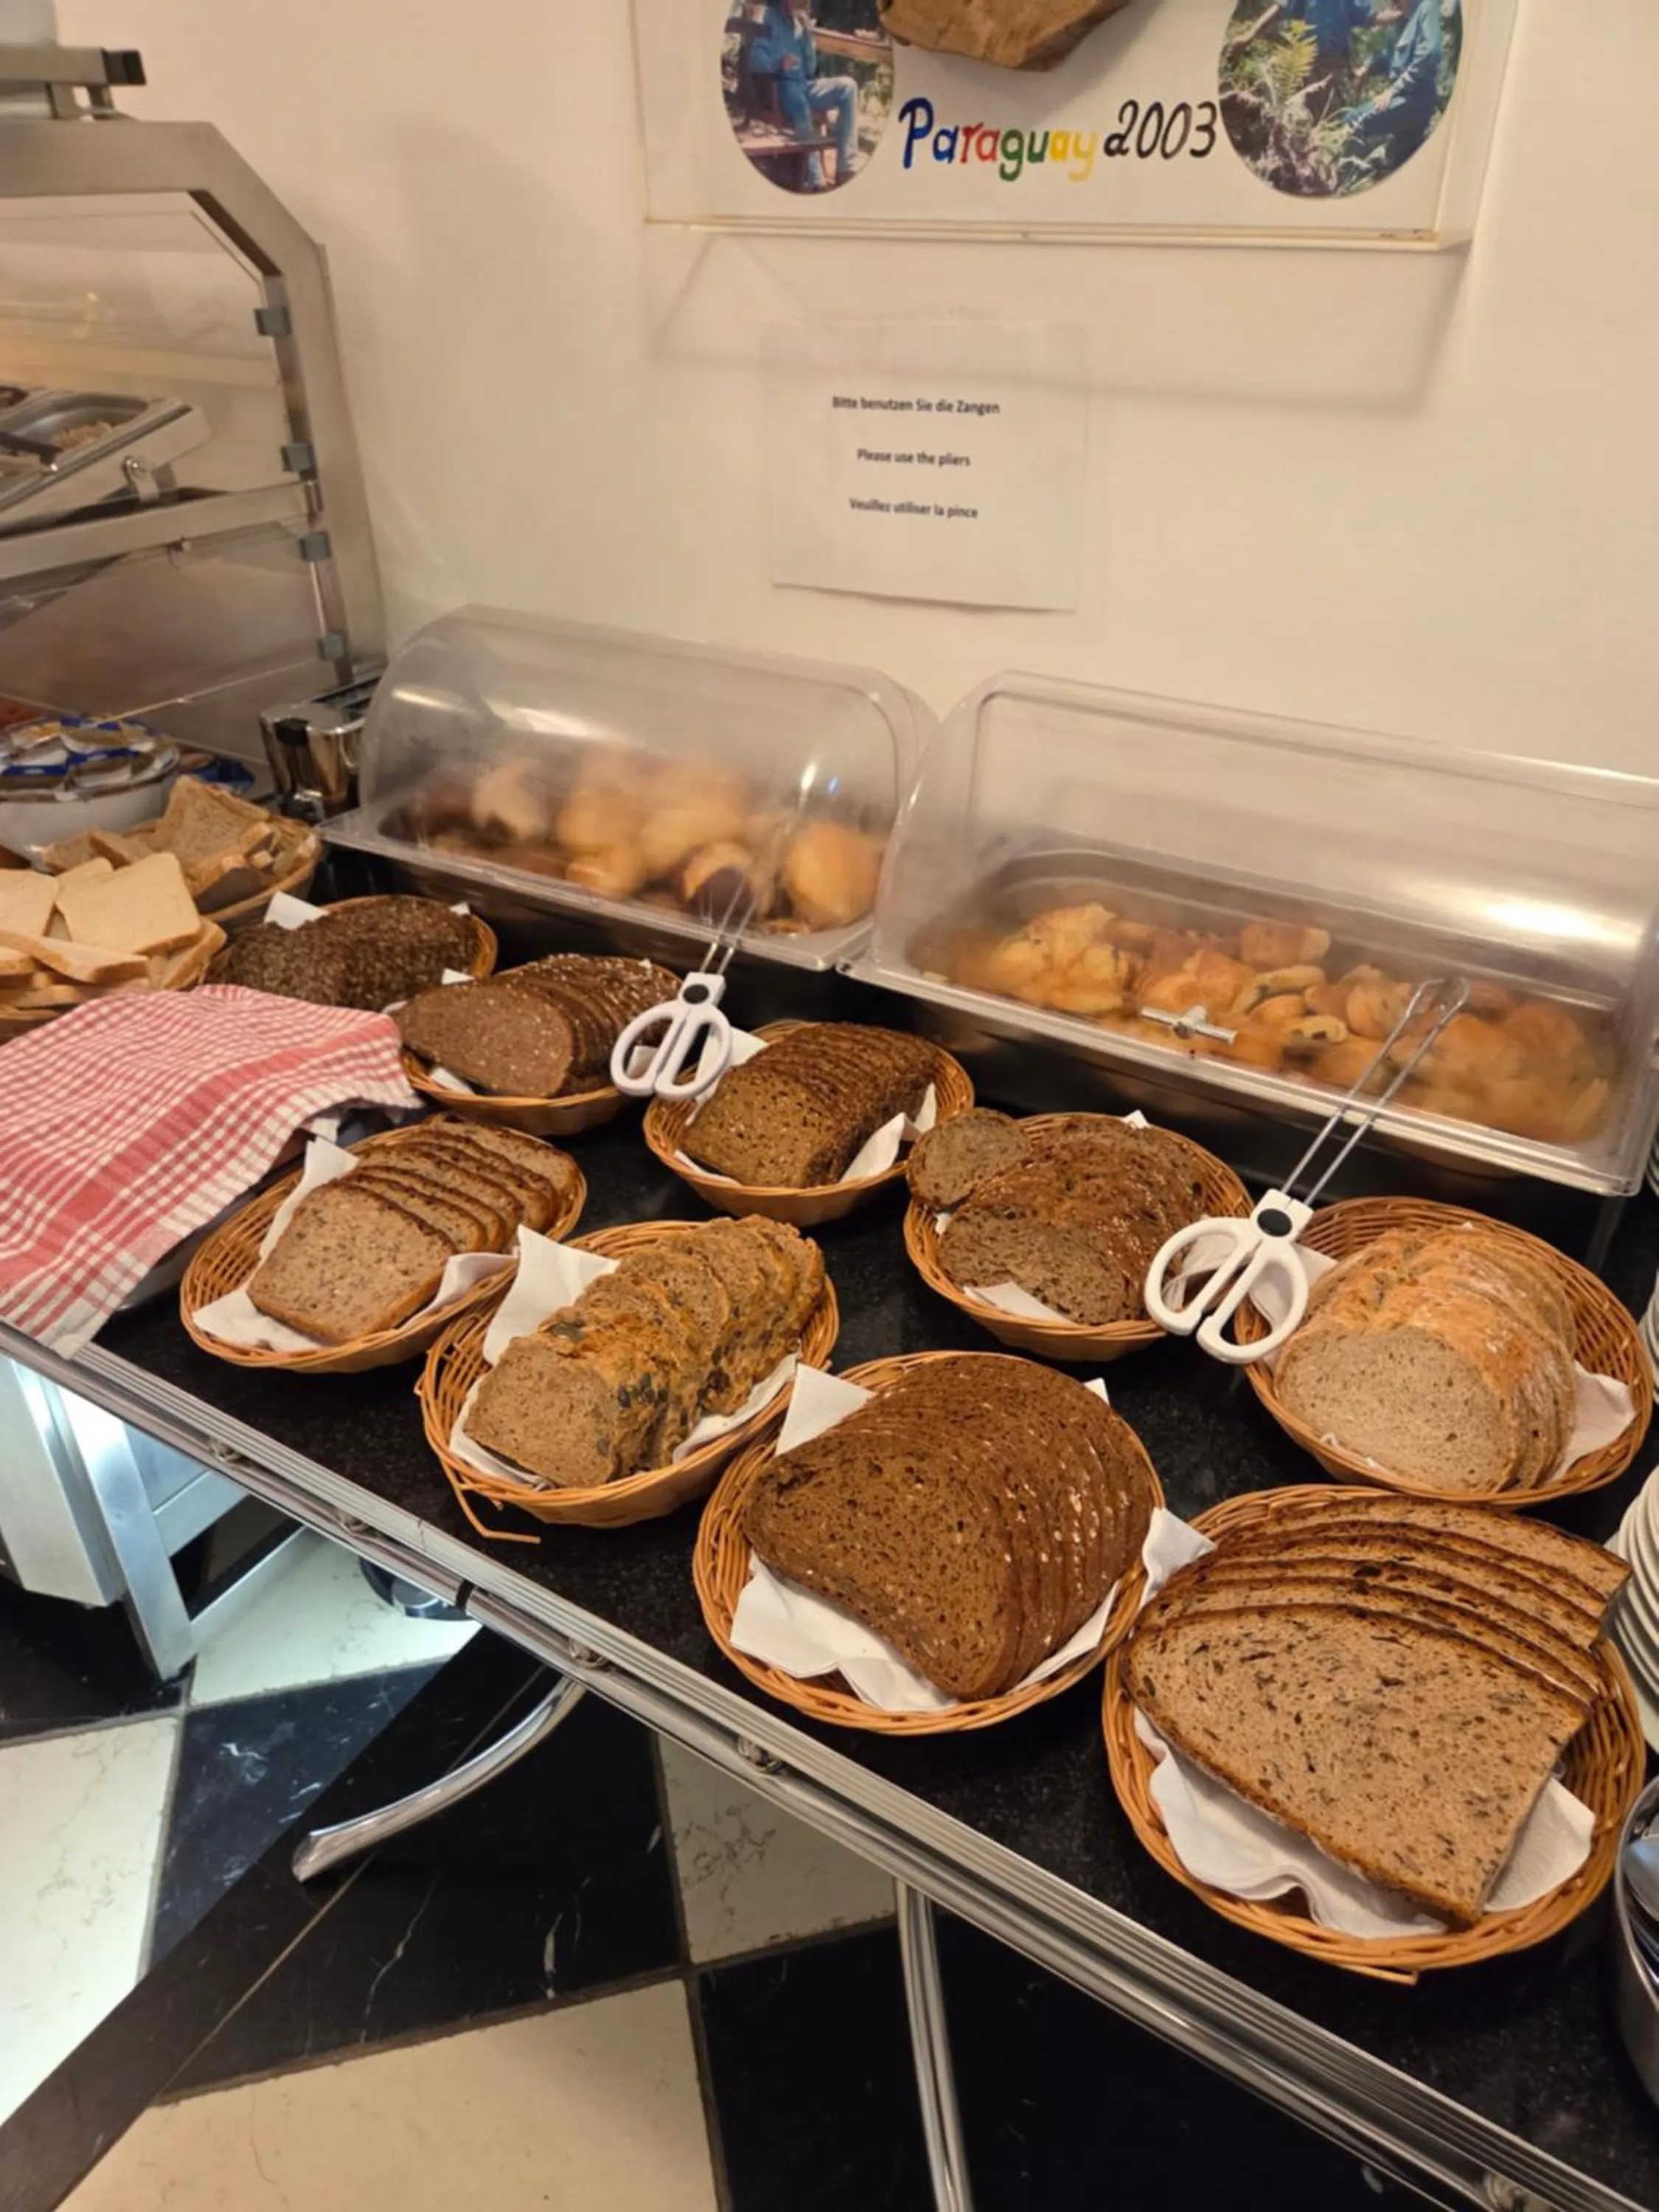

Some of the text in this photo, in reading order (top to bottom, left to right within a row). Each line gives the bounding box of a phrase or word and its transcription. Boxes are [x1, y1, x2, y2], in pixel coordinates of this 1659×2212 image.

[897, 97, 1218, 181] Paraguay 2003
[832, 396, 1001, 416] Bitte benutzen Sie die Zangen
[857, 449, 971, 467] Please use the pliers
[849, 498, 978, 518] Veuillez utiliser la pince
